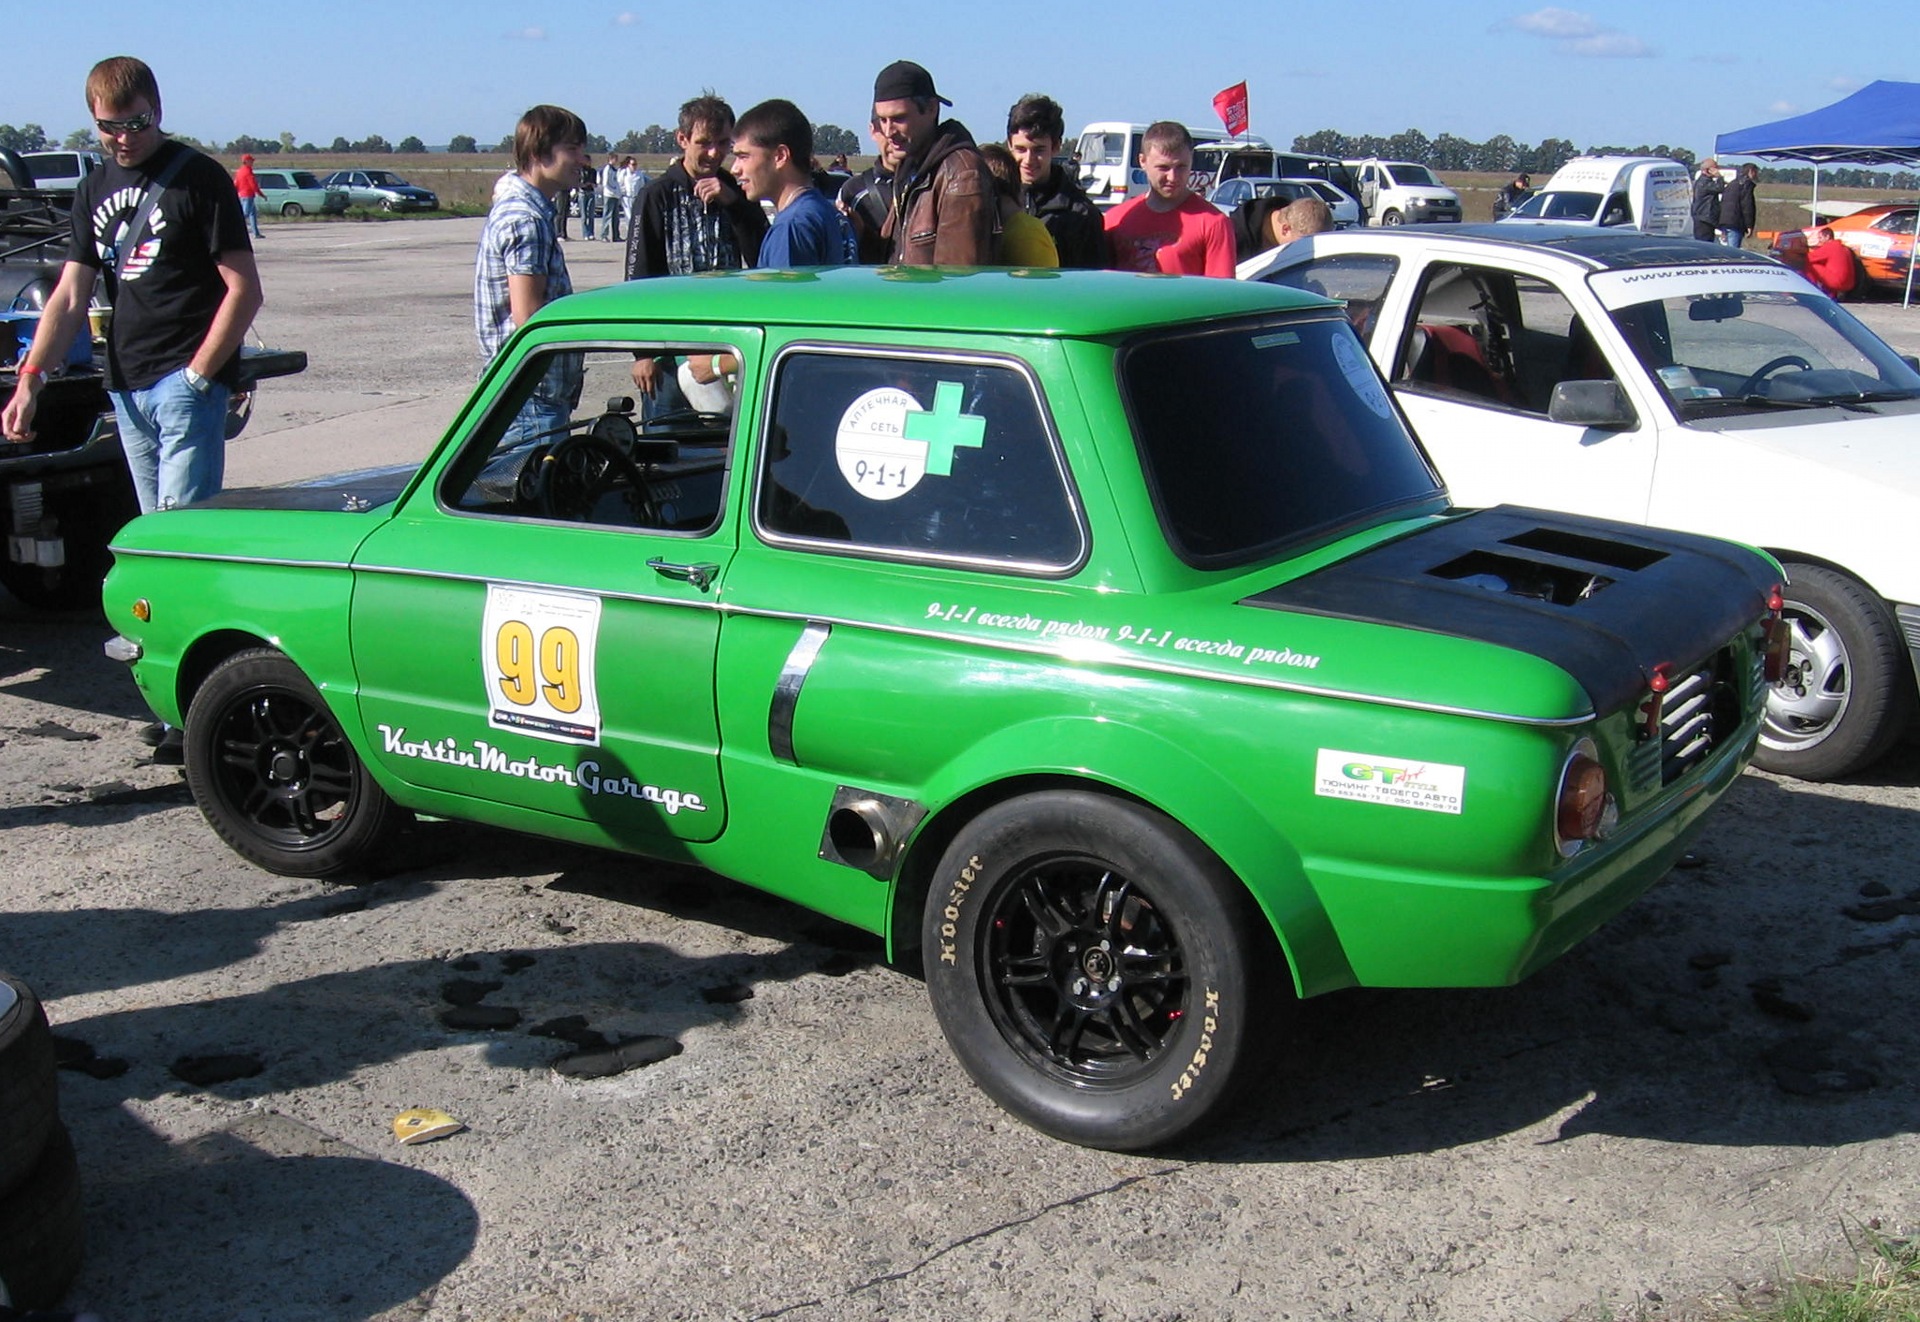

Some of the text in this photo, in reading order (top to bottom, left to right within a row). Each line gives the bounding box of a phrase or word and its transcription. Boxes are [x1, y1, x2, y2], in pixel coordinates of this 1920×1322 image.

[849, 396, 908, 429] АПТЕЧНАЯ
[870, 421, 899, 433] СЕТЬ
[855, 459, 907, 488] 9-1-1
[924, 602, 1321, 669] 9-1-1 всегда рядом 9-1-1 всегда рядом
[496, 619, 583, 714] 99
[1342, 763, 1405, 784] GT
[1322, 779, 1457, 804] ТЮНИНГ ТВОЕГО АВТО
